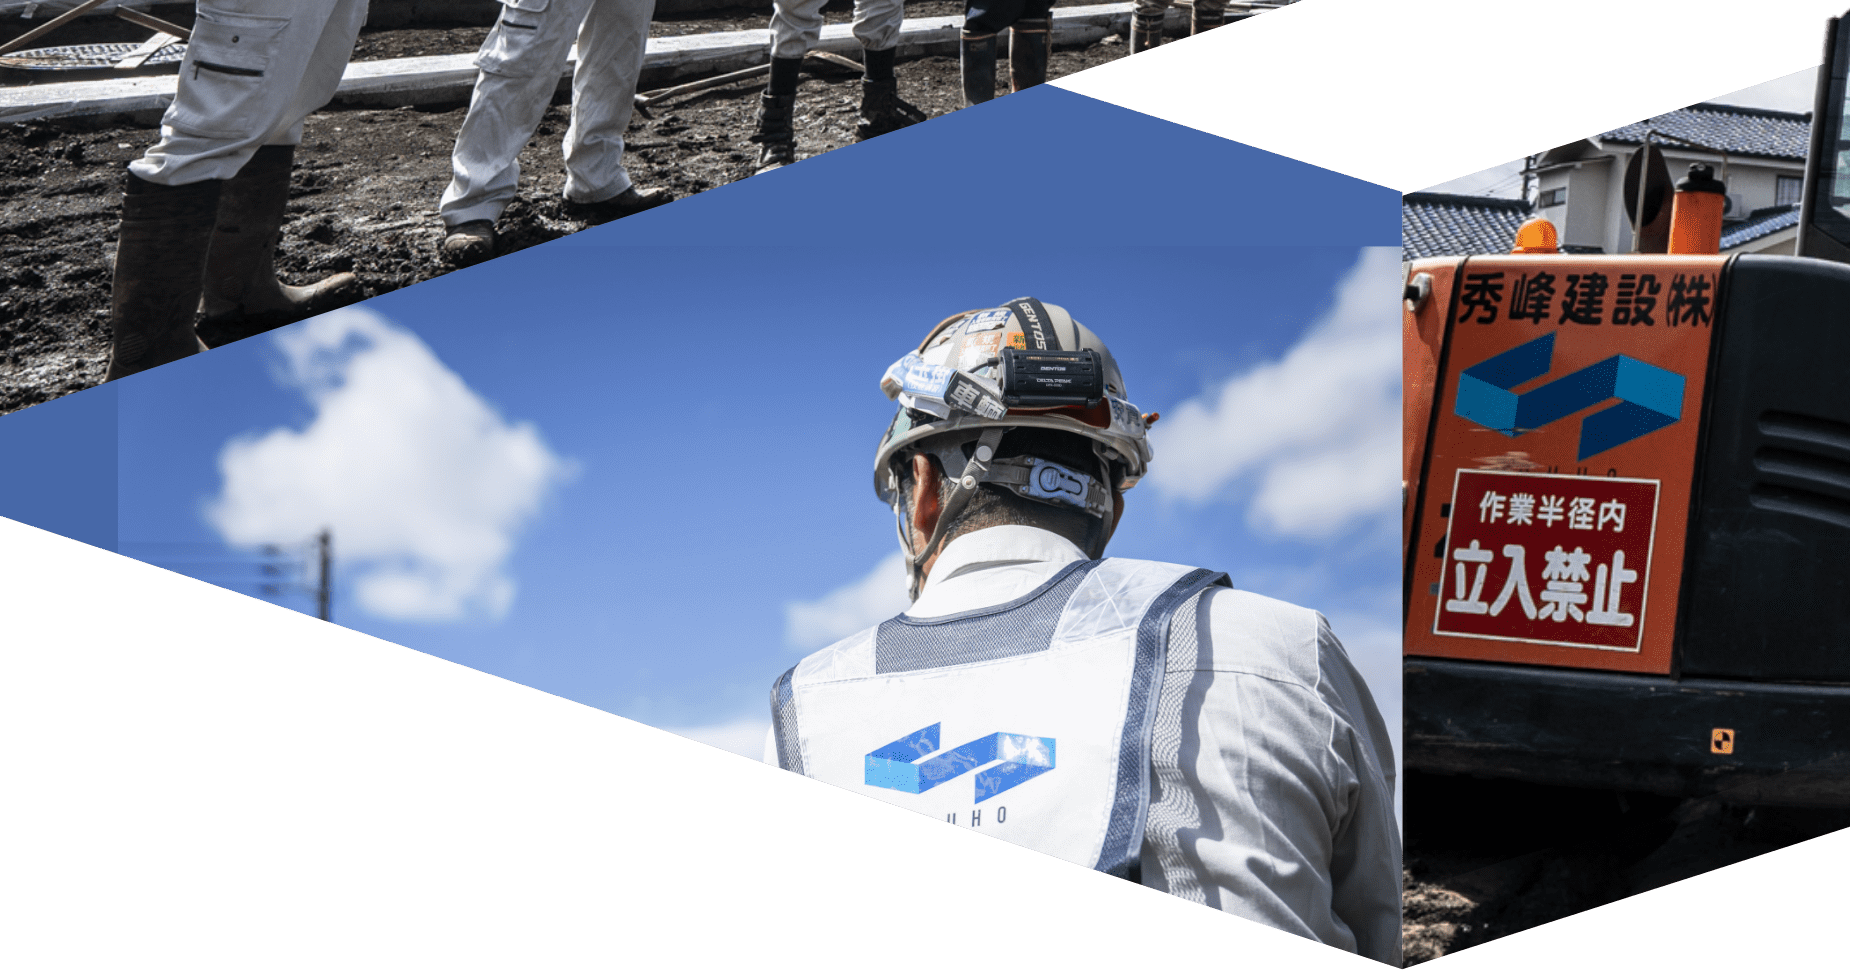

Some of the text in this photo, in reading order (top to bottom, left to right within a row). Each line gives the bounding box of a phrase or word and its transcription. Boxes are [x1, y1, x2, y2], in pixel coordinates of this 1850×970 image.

[1458, 271, 1717, 328] 秀峰建設(株)
[1018, 302, 1047, 350] GENTOS
[1479, 490, 1628, 533] 作業半径内
[1445, 538, 1638, 627] 立入禁止
